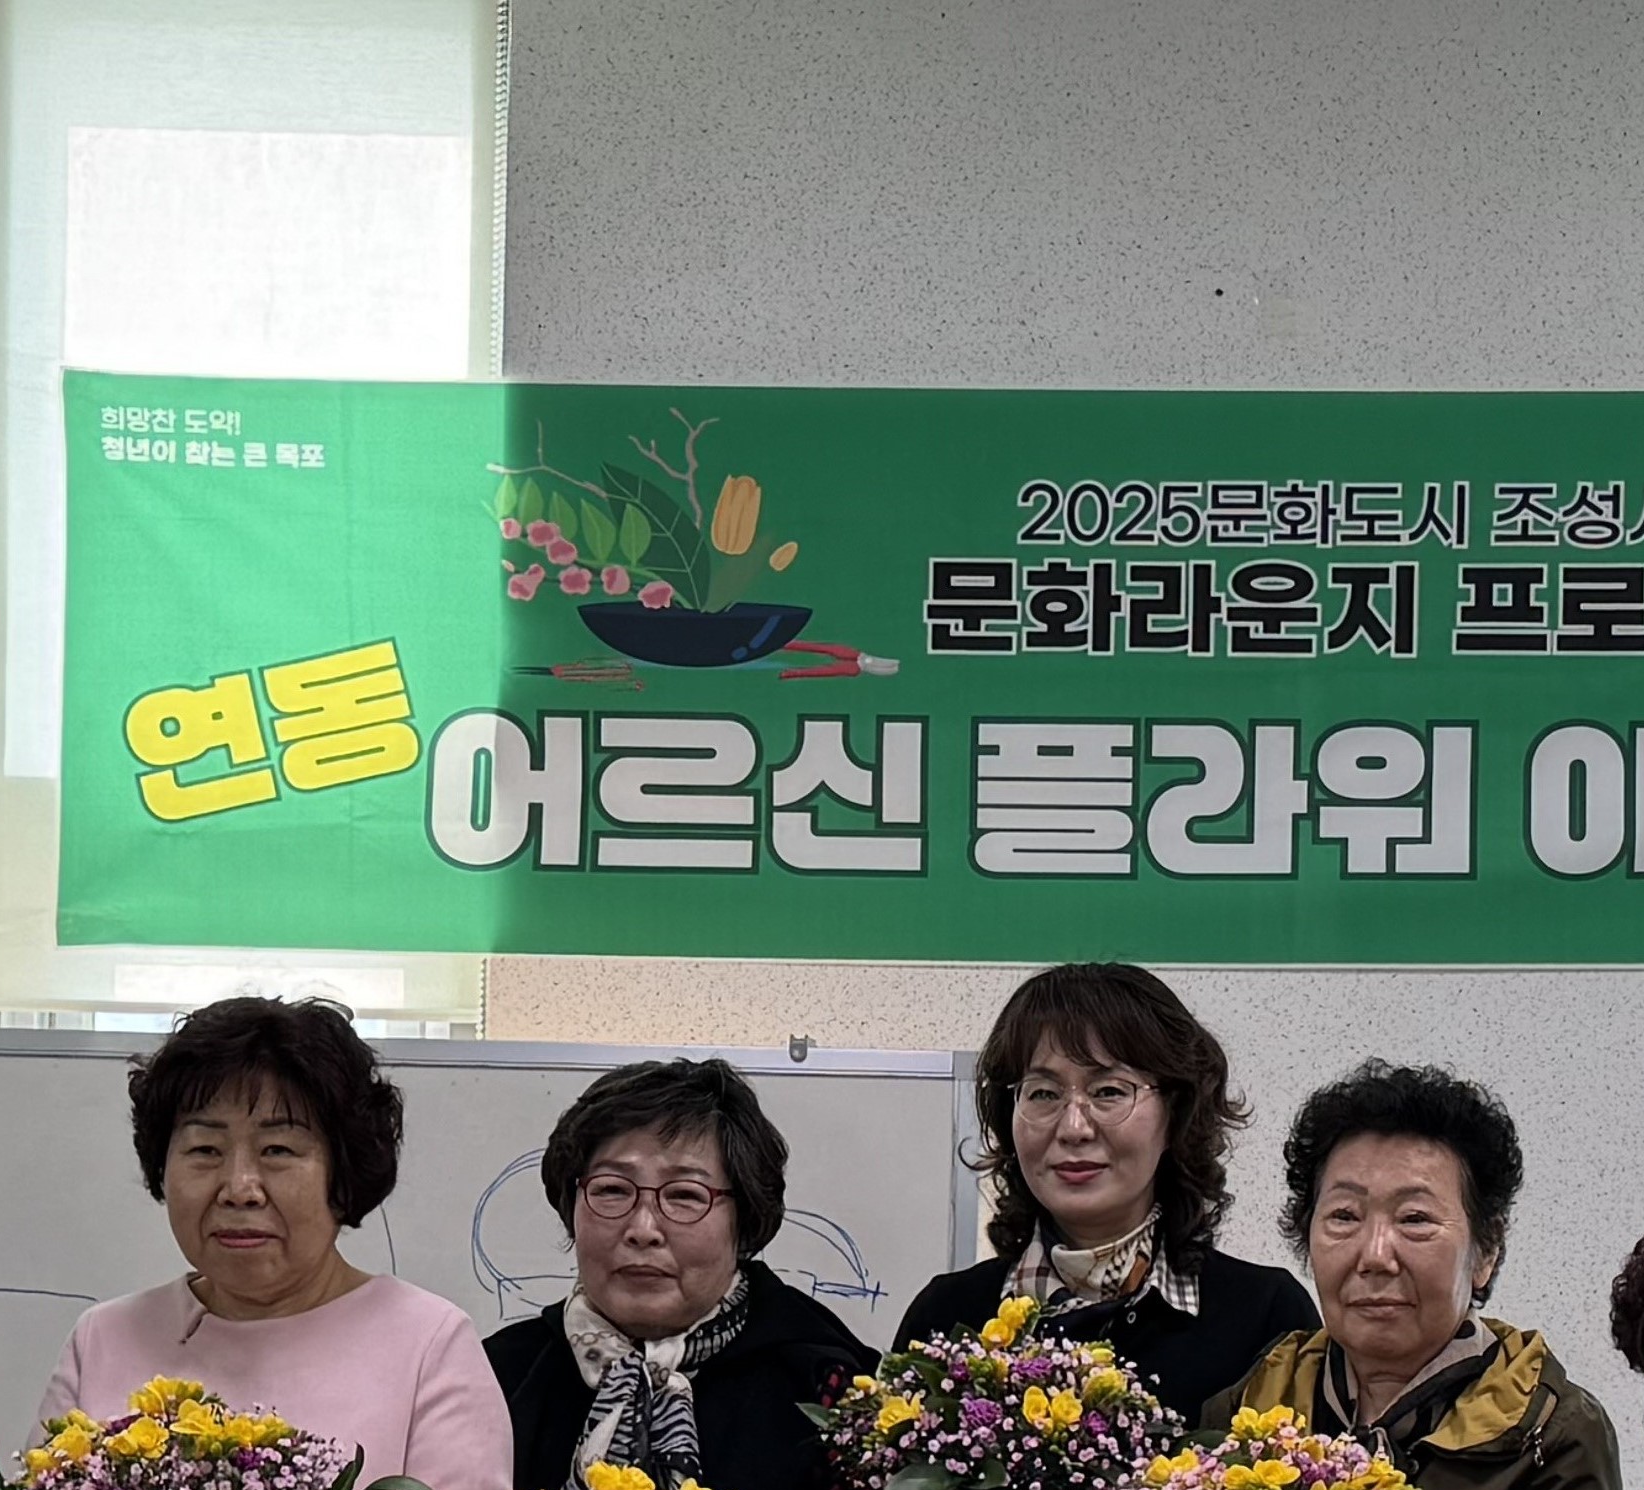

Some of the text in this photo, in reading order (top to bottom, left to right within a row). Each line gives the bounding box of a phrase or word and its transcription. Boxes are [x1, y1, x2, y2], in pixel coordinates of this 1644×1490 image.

[101, 406, 242, 436] 희망찬 도약!
[101, 436, 177, 464] 청년이
[243, 442, 268, 468] 큰
[275, 442, 326, 469] 목포
[1016, 480, 1469, 548] 2025문화도시
[922, 556, 1419, 658] 문화라운지
[122, 636, 423, 824] 연동
[425, 708, 929, 878] 어르신
[968, 716, 1479, 881] 플라워
